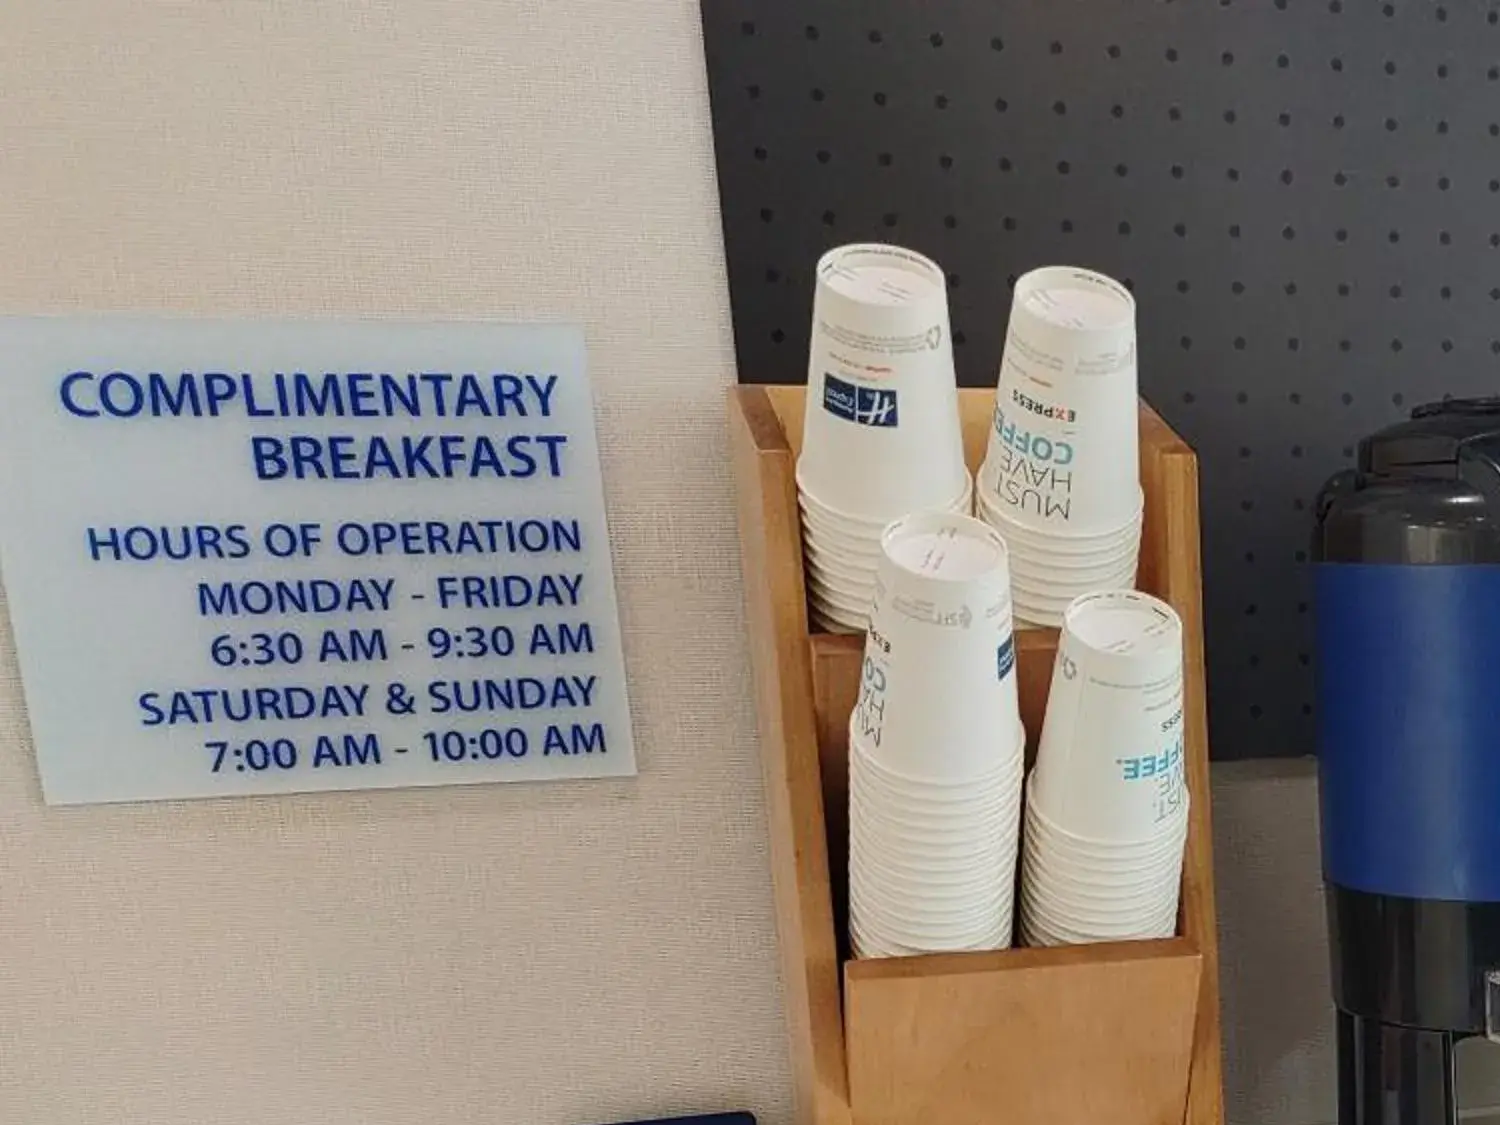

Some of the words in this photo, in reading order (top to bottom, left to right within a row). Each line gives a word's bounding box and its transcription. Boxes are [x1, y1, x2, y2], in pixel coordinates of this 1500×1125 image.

[60, 371, 559, 418] COMPLIMENTARY
[1012, 388, 1075, 423] EXPRESS
[251, 435, 568, 481] BREAKFAST
[994, 407, 1074, 466] COFFE
[88, 525, 251, 561] HOURS
[264, 523, 322, 558] OF
[338, 519, 582, 557] OPERATION
[198, 579, 396, 616] MONDAY
[438, 573, 584, 610] FRIDAY
[211, 631, 303, 667] 6:30
[319, 628, 388, 662] AM
[427, 626, 515, 659] 9:30
[530, 623, 595, 655] AM
[139, 684, 370, 726] SATURDAY
[386, 684, 417, 714] &
[430, 675, 598, 714] SUNDAY
[205, 738, 298, 773] 7:00
[313, 732, 382, 768] AM
[423, 728, 529, 763] 10:00
[542, 724, 607, 757] AM
[1115, 741, 1182, 780] FFEE.
